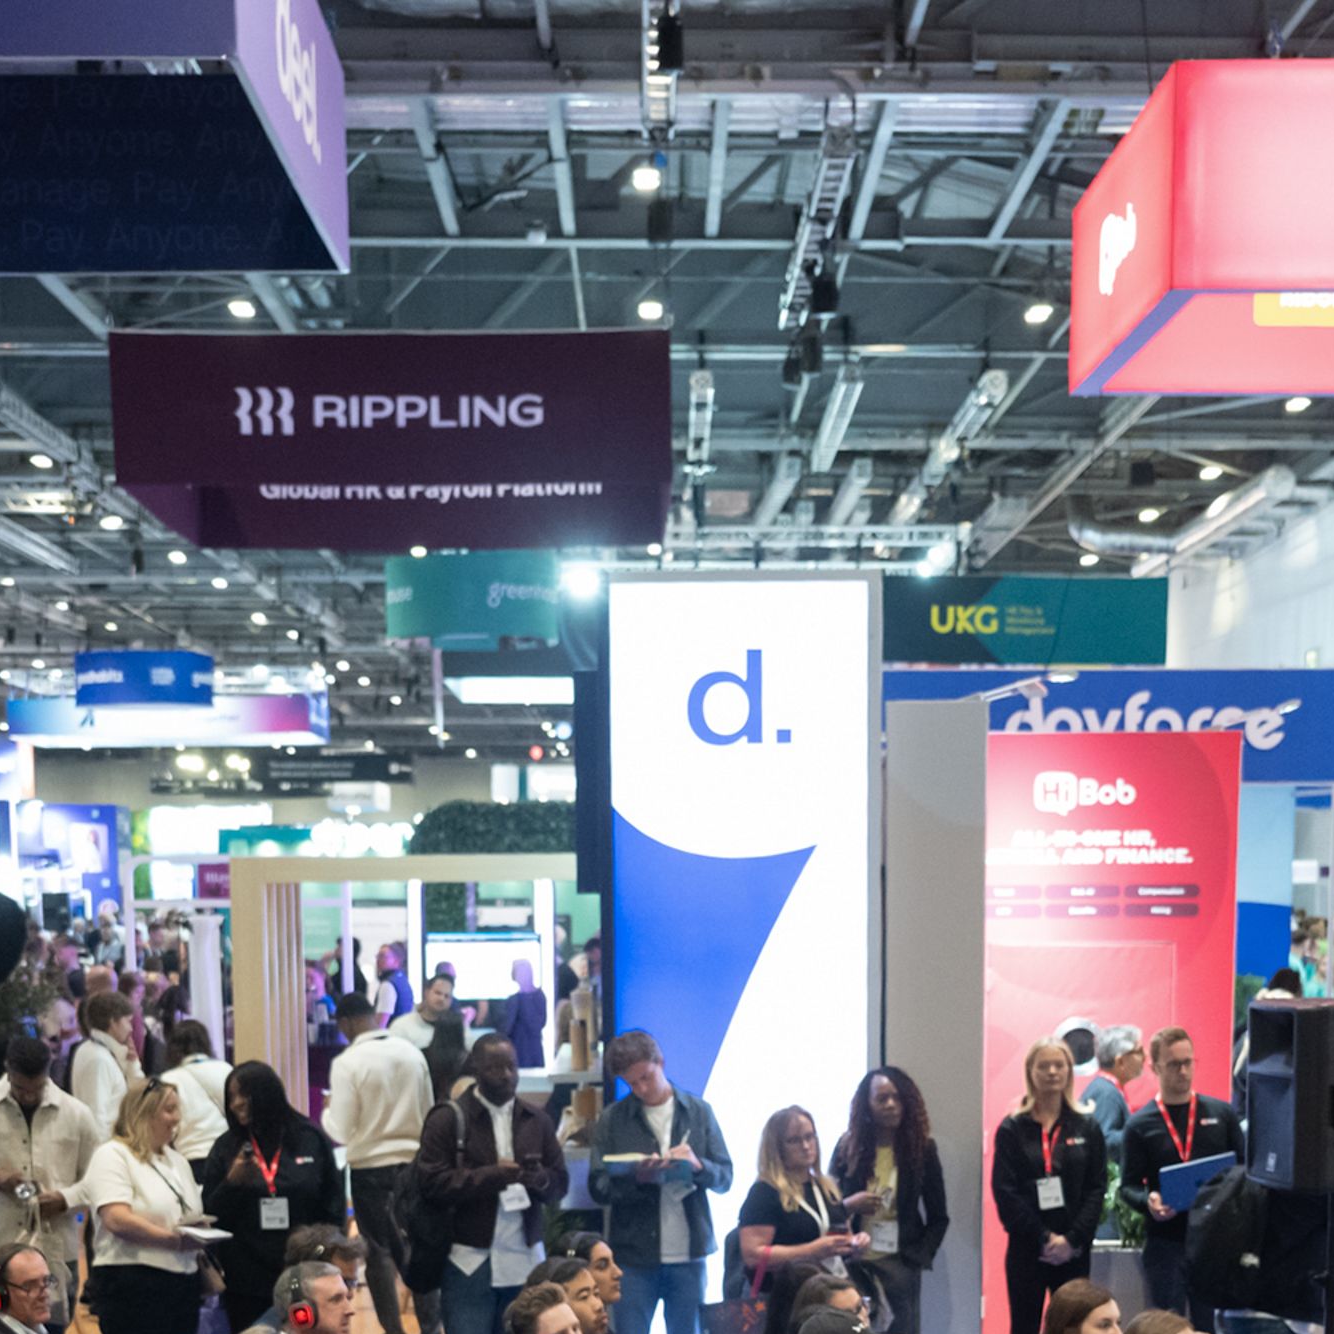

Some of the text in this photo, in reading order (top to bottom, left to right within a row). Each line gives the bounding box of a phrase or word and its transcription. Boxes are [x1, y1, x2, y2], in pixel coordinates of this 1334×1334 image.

[312, 393, 545, 429] RIPPLING
[930, 604, 999, 634] UKG
[1035, 774, 1137, 811] HiBob
